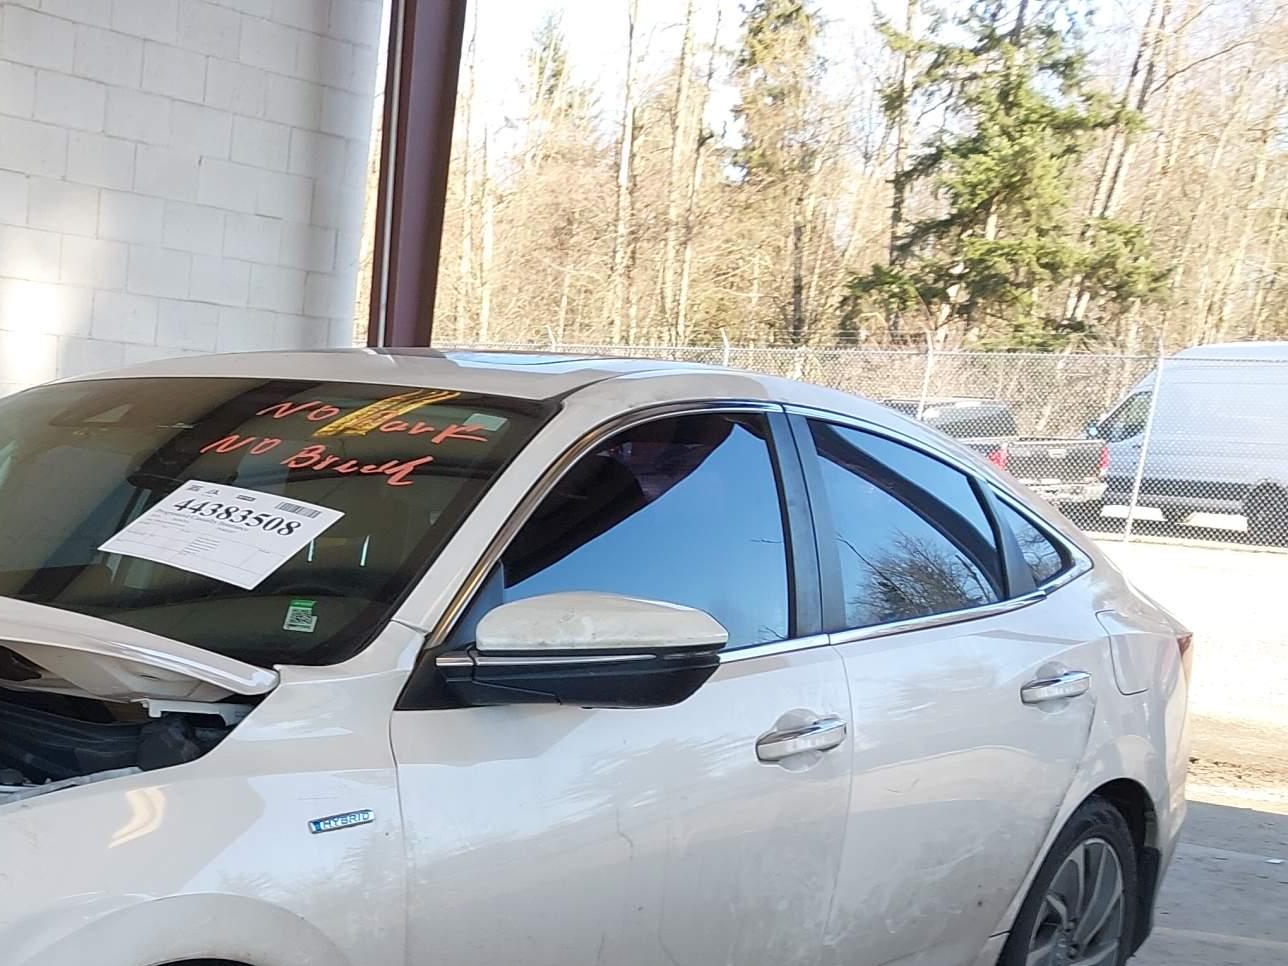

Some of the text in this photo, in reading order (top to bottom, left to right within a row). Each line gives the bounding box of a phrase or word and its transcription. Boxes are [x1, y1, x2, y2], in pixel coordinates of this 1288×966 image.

[199, 434, 281, 455] NO
[173, 498, 302, 536] 44383508
[322, 811, 370, 830] HYBRID
